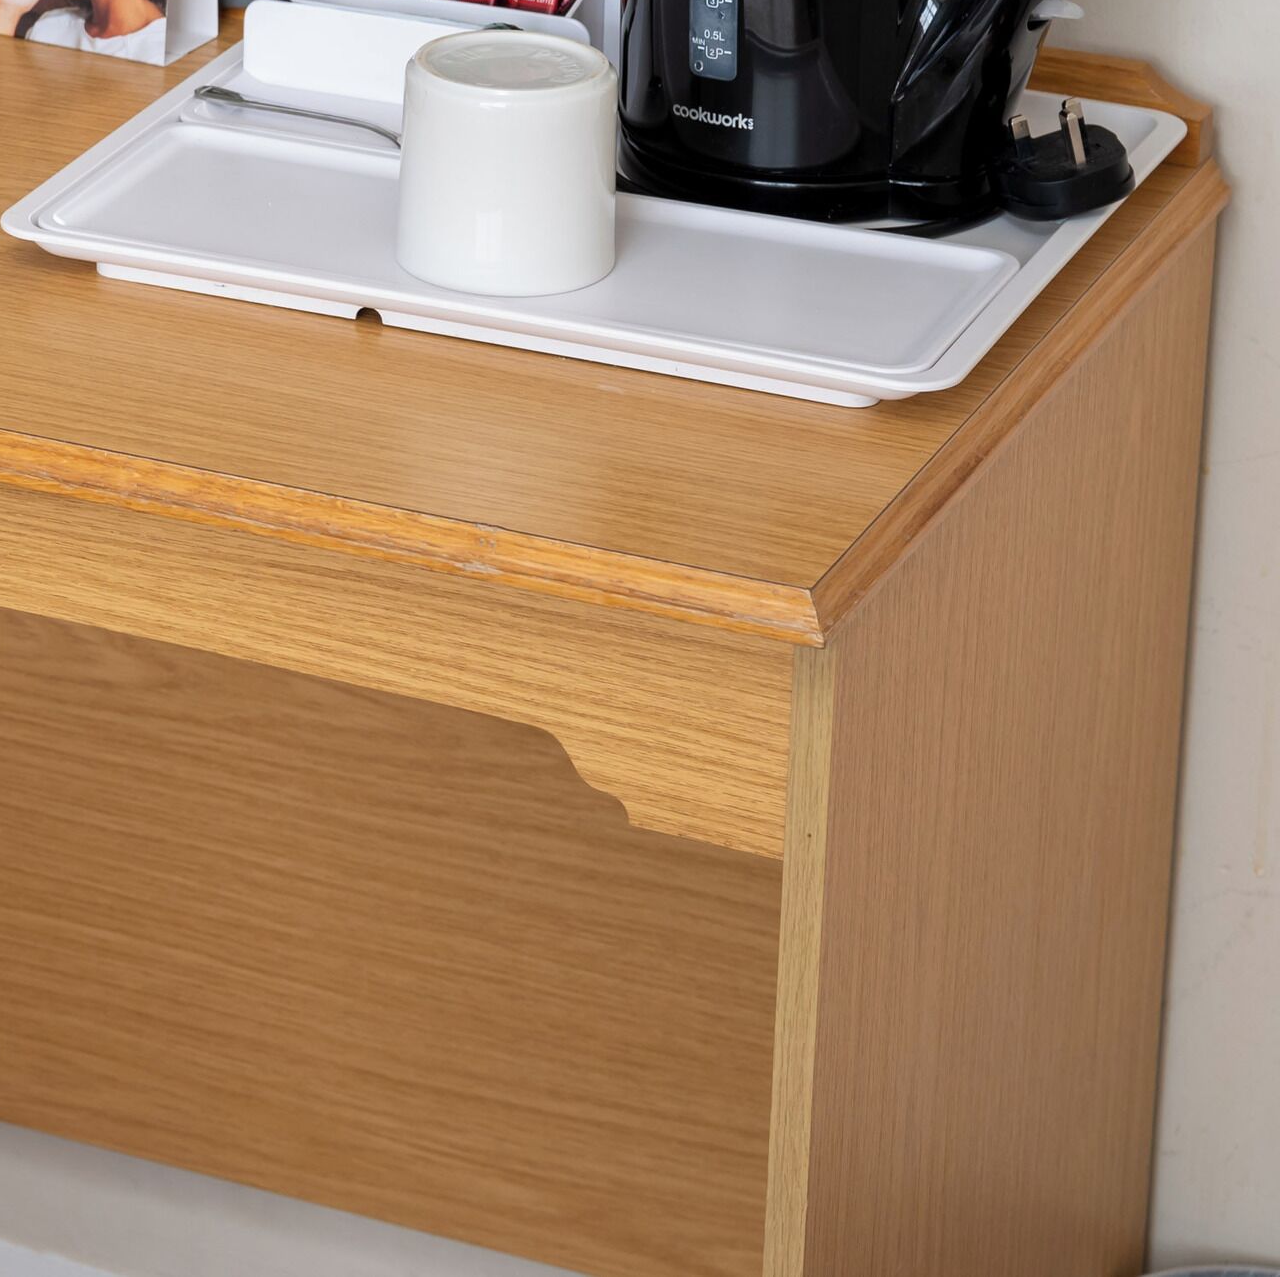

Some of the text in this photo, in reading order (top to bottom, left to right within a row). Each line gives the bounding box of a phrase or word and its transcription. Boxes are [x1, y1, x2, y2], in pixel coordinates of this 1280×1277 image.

[692, 36, 706, 45] MIN
[704, 29, 725, 42] 0.5L
[673, 104, 754, 130] cookworks
